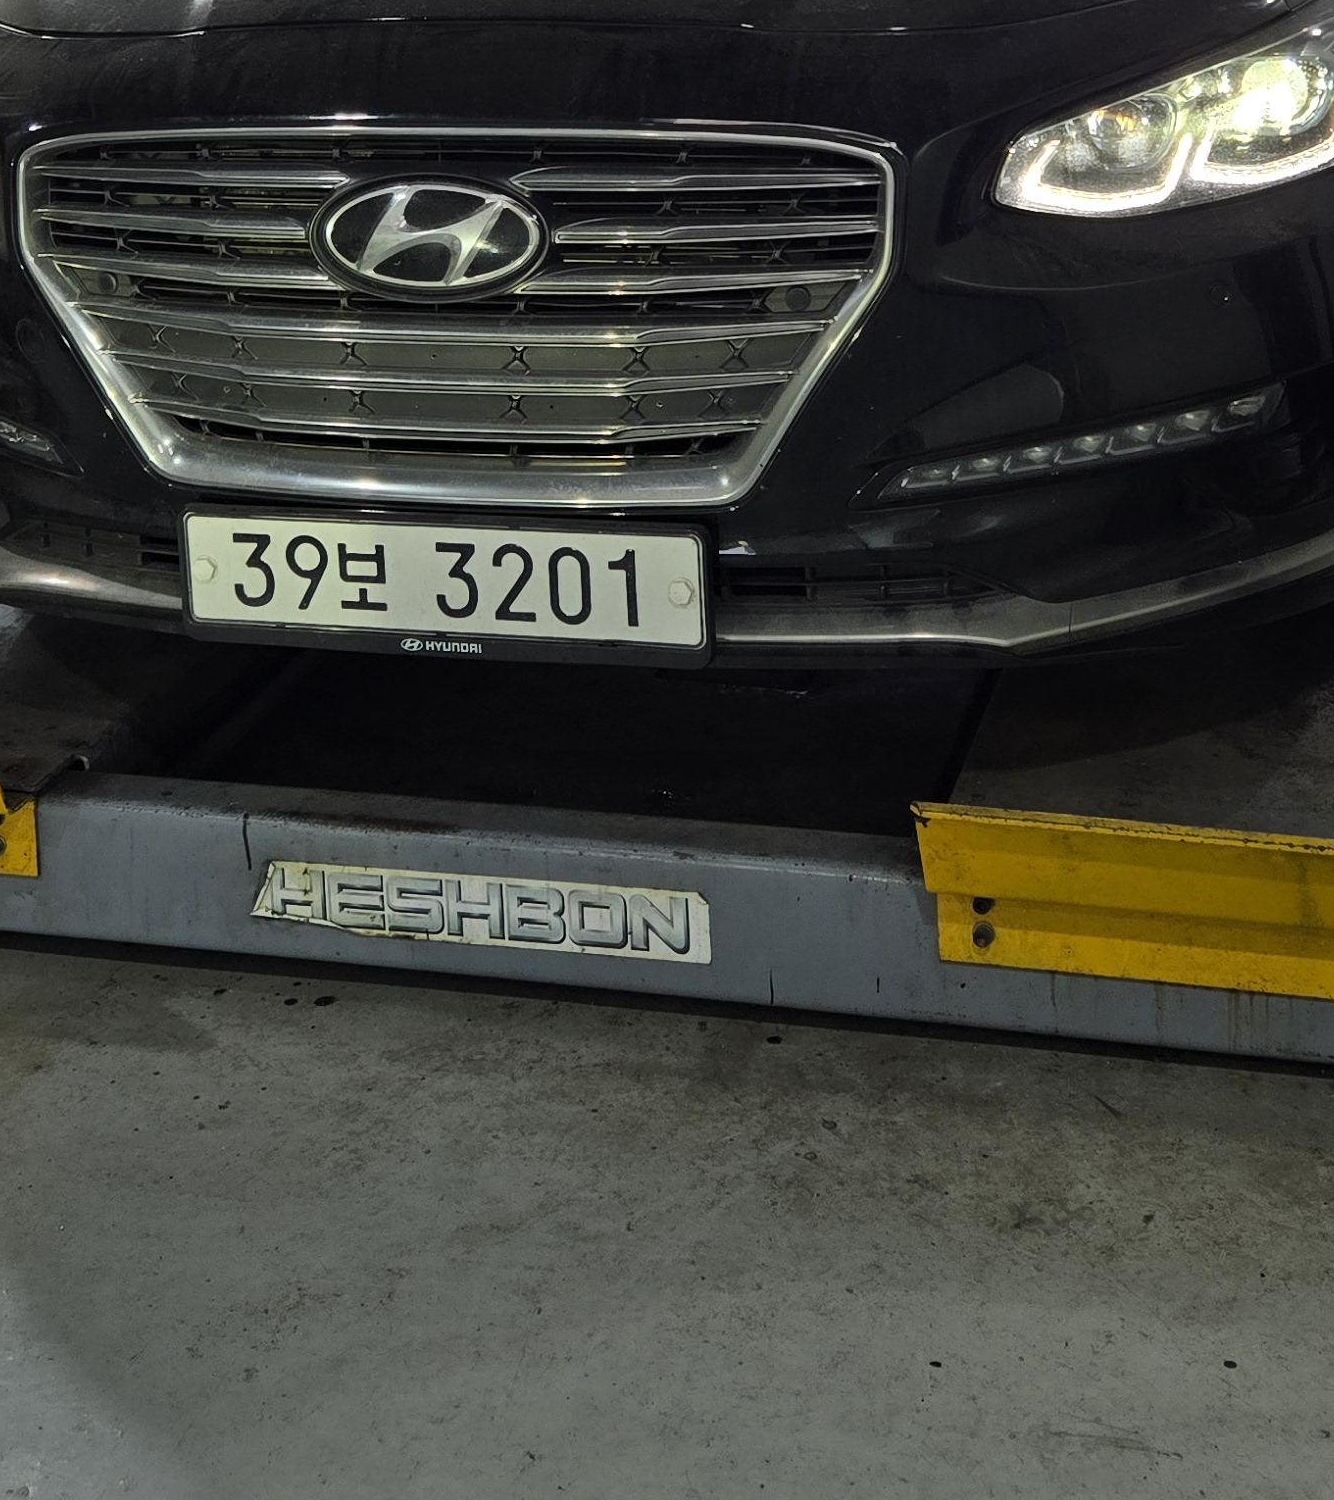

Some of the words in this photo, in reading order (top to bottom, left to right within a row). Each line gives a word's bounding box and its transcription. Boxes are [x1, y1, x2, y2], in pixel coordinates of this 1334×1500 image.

[232, 533, 388, 612] 39보
[435, 541, 641, 628] 3201
[425, 640, 482, 654] HYUNDAI
[271, 866, 691, 955] HESHBON
